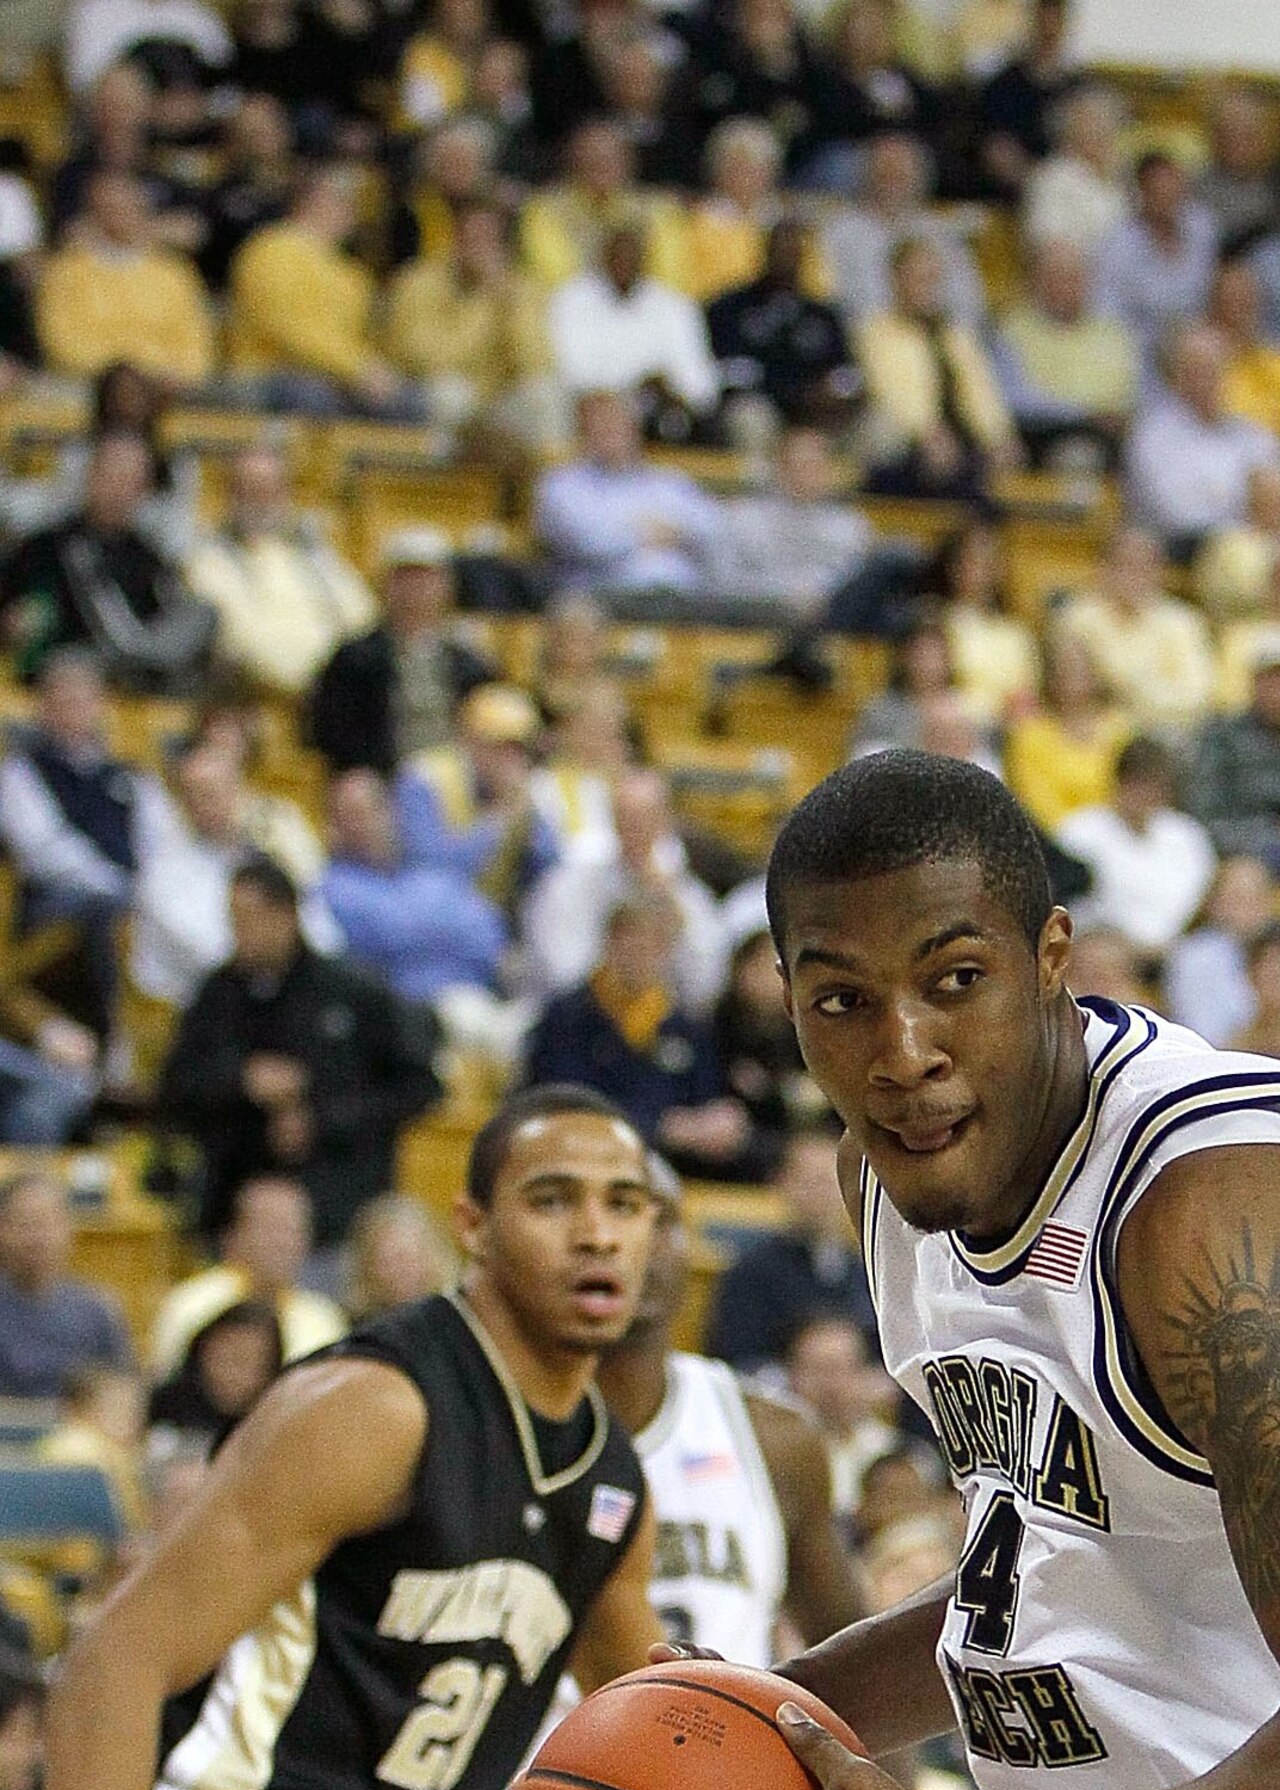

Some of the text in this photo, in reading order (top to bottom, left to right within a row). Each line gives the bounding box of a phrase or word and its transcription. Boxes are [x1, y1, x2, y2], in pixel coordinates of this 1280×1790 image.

[922, 1354, 1111, 1534] ORGIA
[955, 1489, 1025, 1659] 4
[943, 1648, 1110, 1769] ECH
